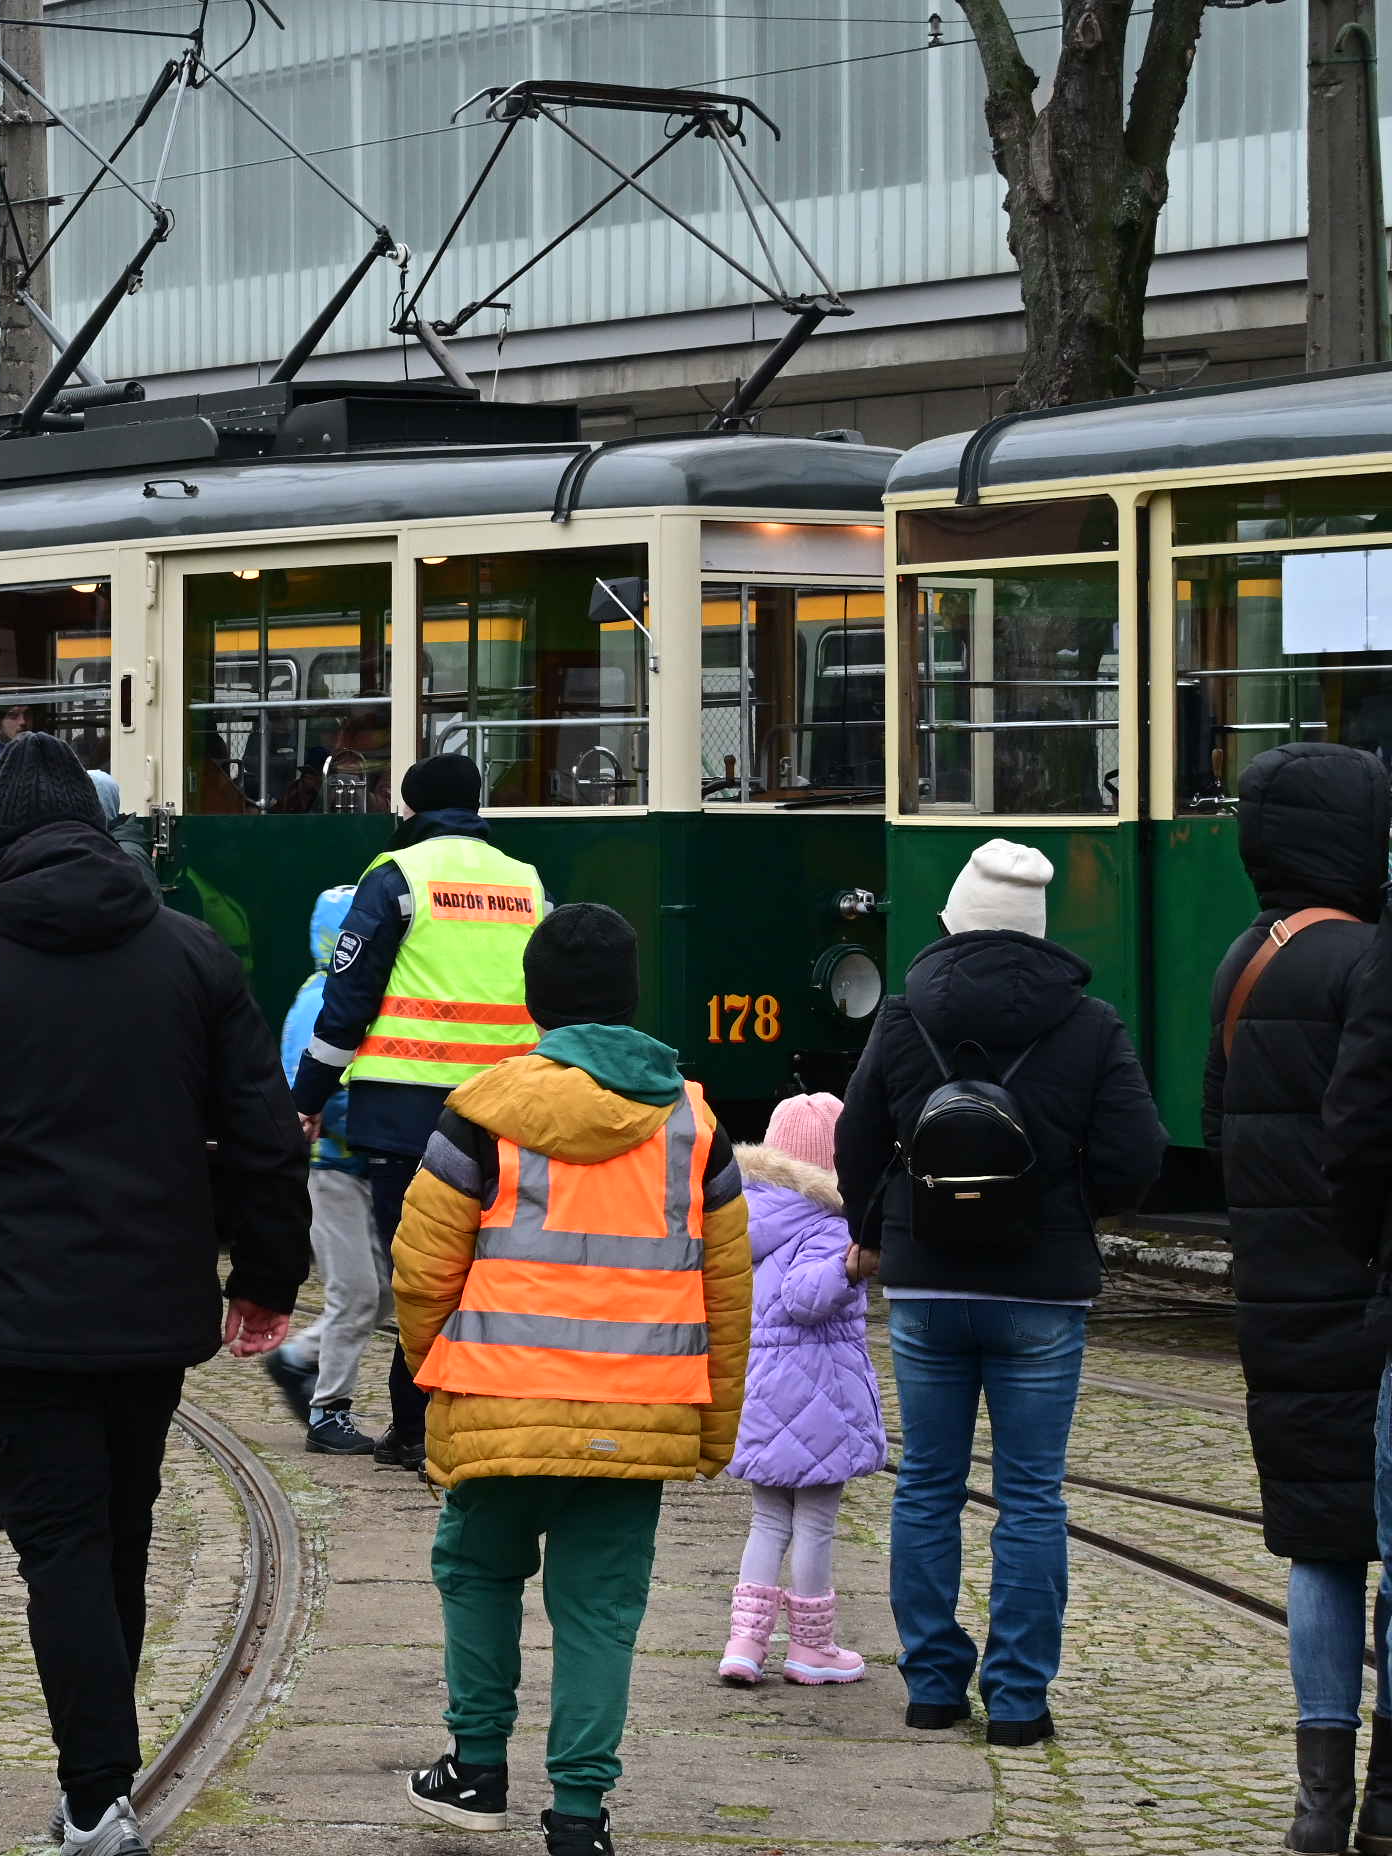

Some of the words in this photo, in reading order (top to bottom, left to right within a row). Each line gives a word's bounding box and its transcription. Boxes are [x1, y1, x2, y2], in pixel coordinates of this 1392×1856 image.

[433, 890, 485, 910] NADZÓR
[487, 895, 533, 914] RUCHU
[707, 994, 782, 1044] 178
